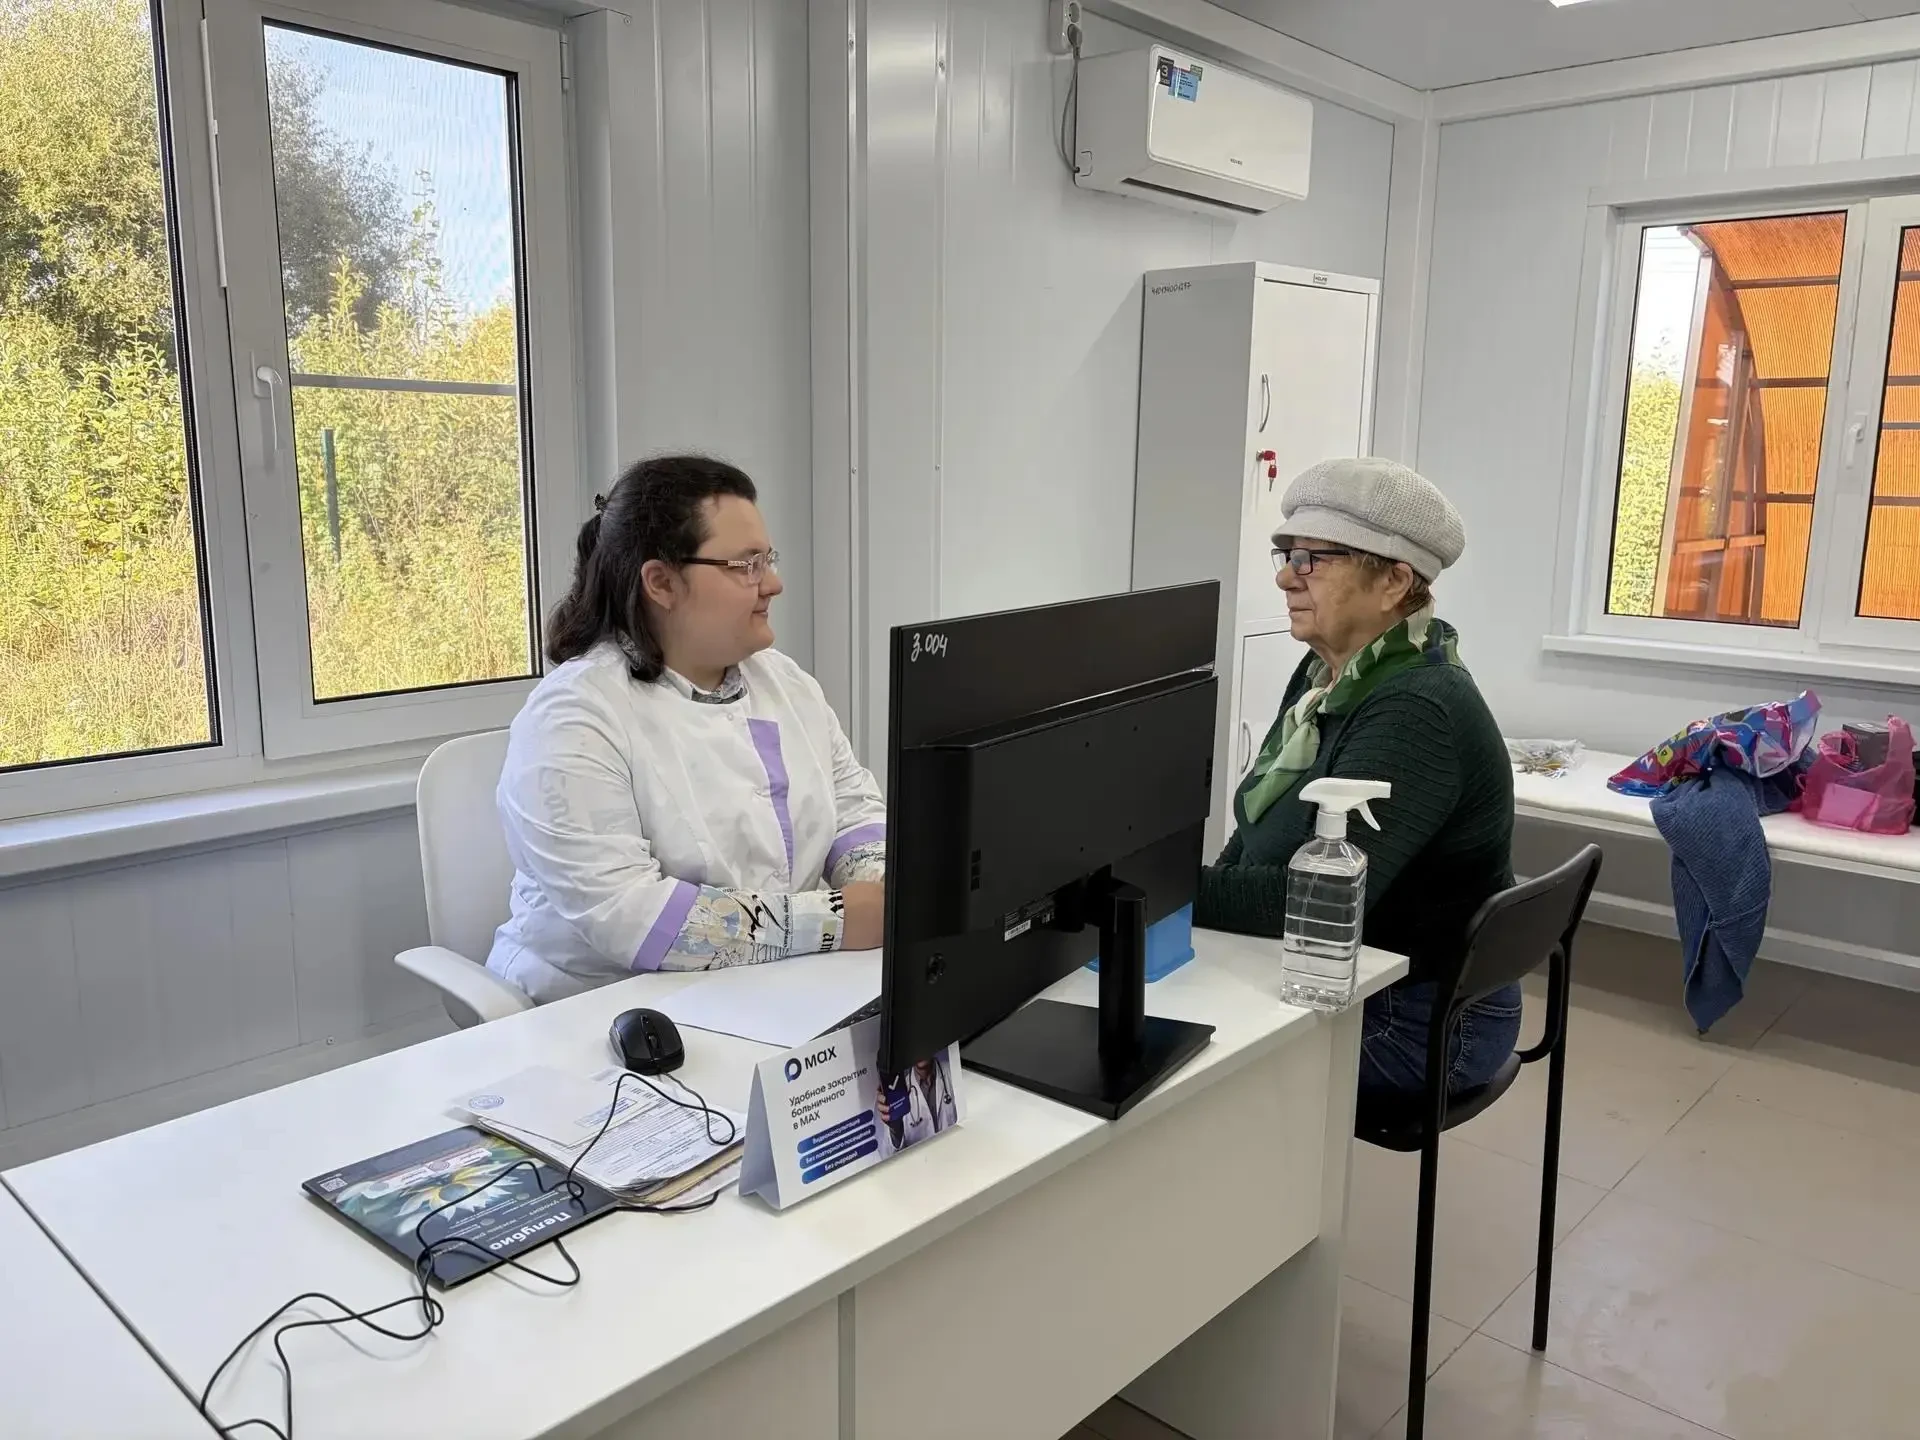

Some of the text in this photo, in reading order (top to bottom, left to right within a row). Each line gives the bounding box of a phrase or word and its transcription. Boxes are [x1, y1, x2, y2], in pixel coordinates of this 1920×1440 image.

[789, 1067, 868, 1107] Удобное закрытие
[791, 1089, 845, 1118] больничного
[793, 1122, 799, 1130] в
[489, 1211, 572, 1250] Пелубио
